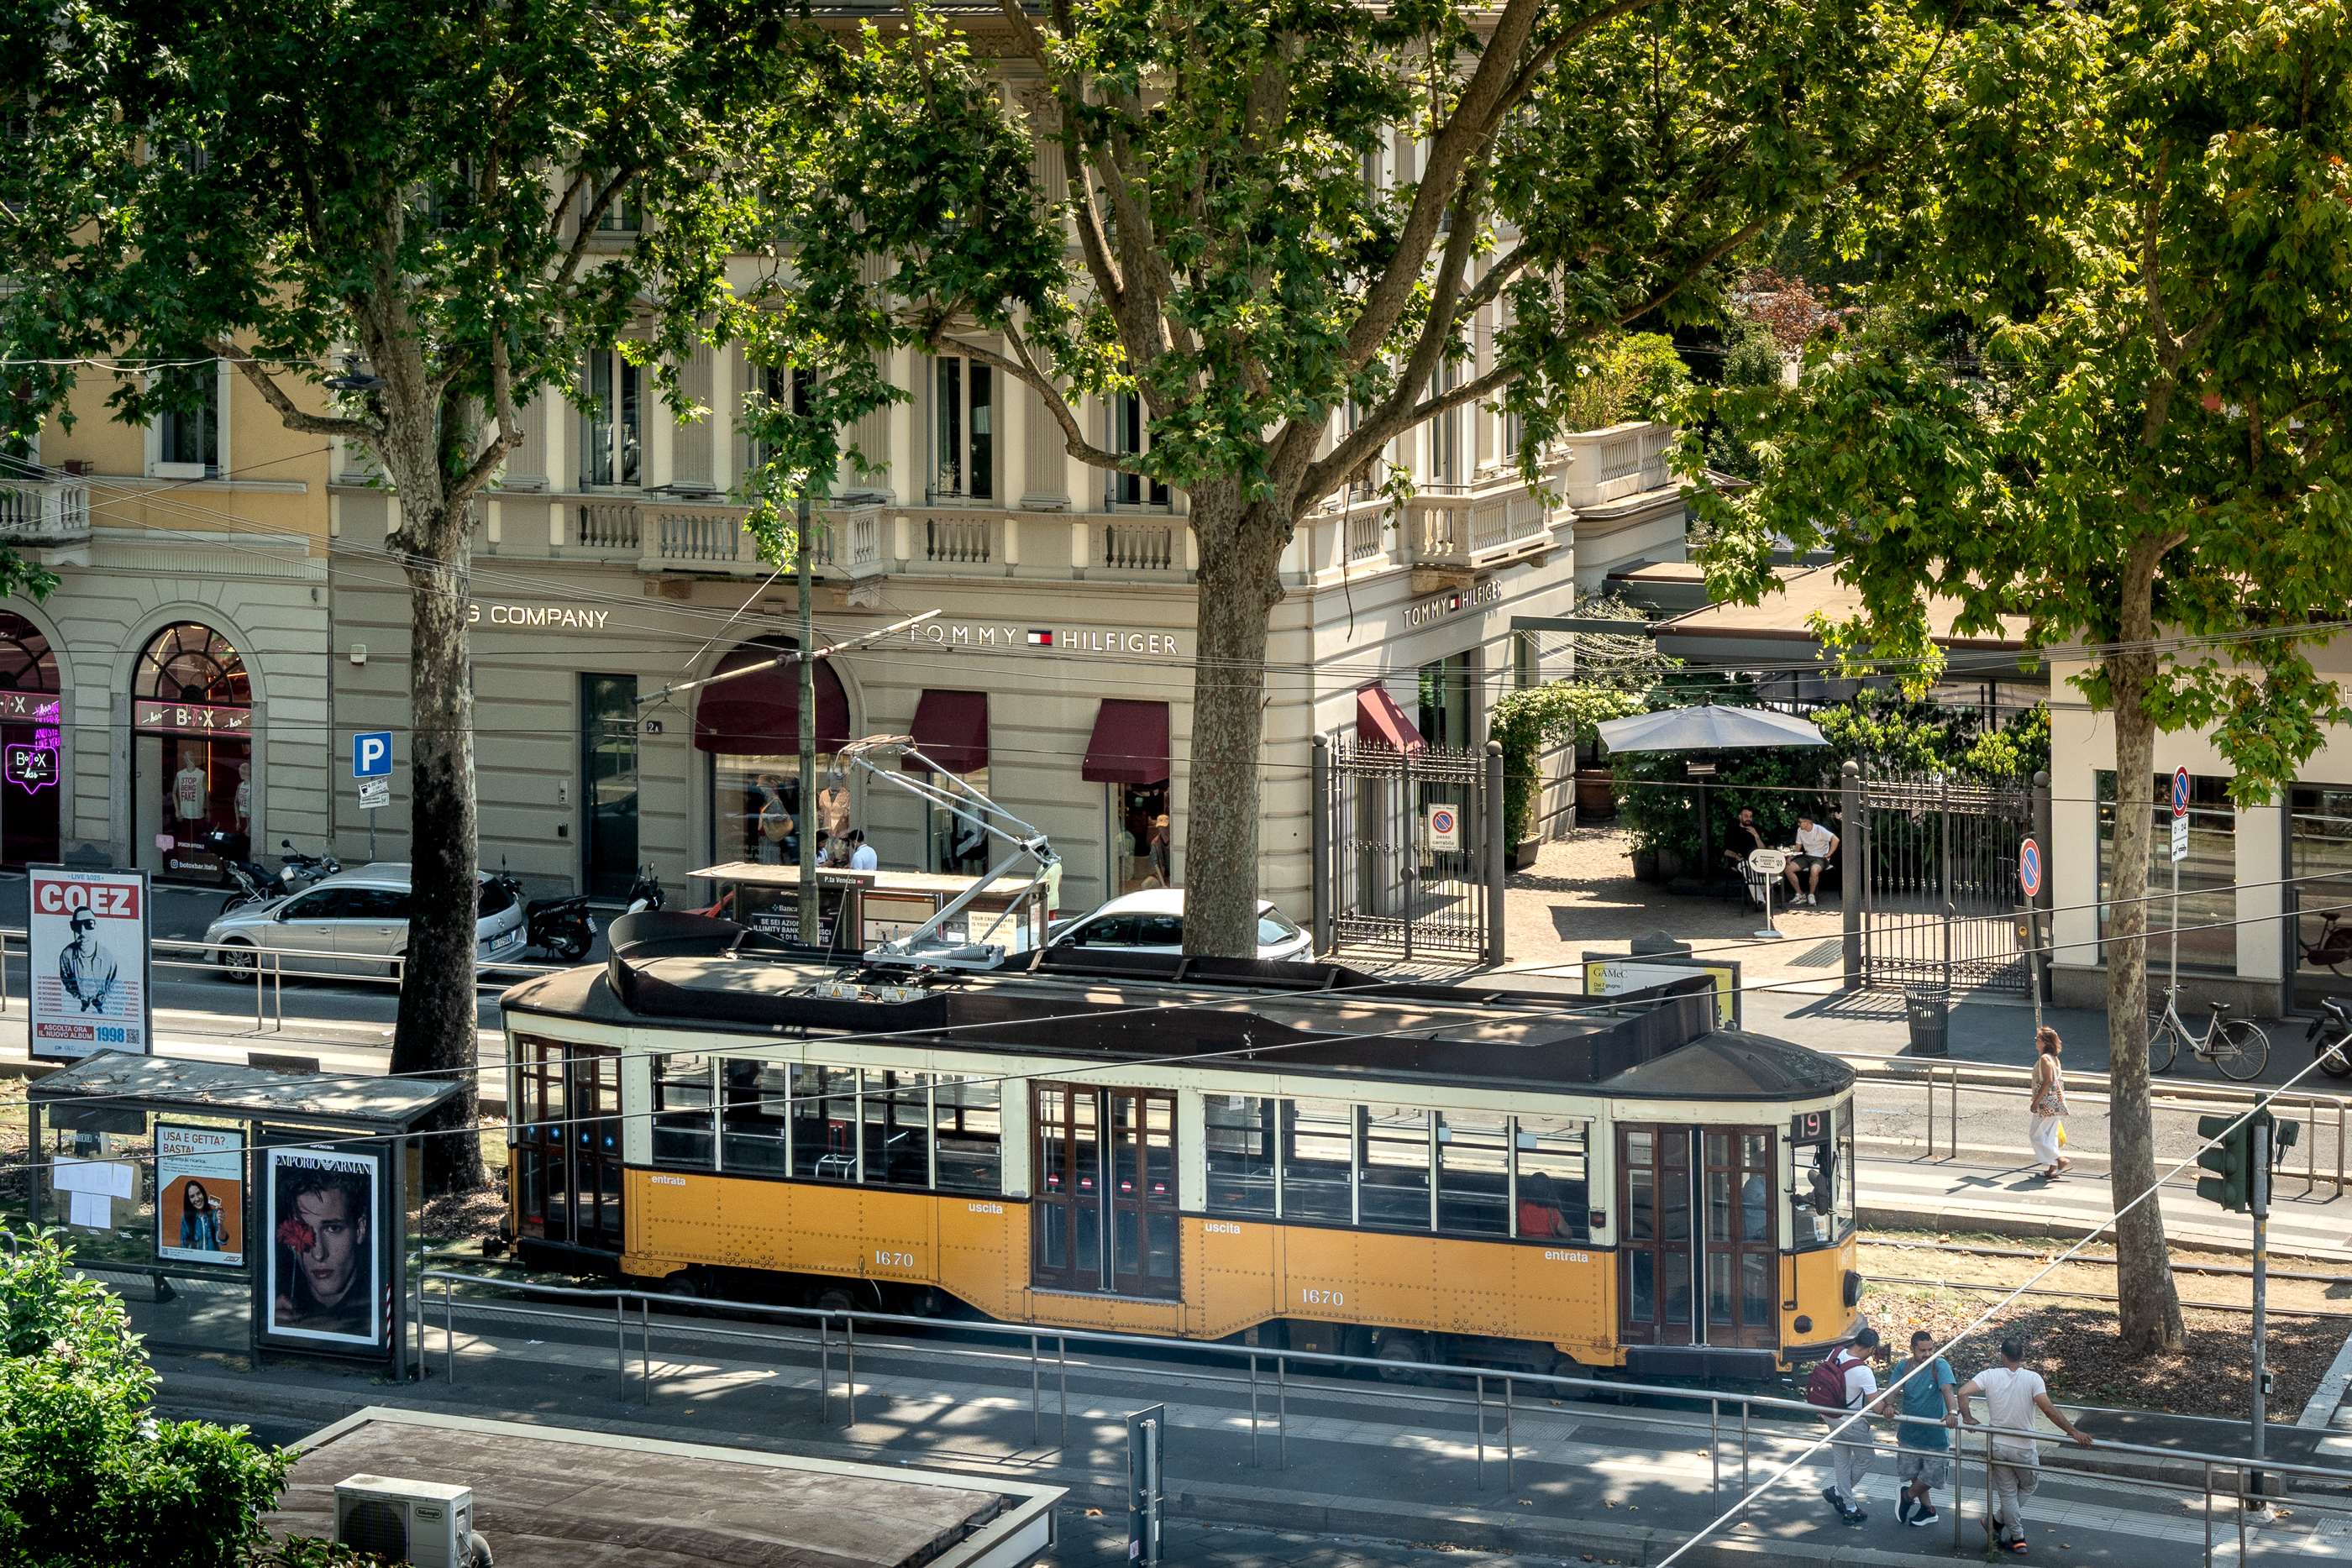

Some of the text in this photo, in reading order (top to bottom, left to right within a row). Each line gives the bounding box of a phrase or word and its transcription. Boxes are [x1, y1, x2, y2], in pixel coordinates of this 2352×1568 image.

[1404, 579, 1503, 627] TOMMY HILFIGER
[491, 606, 609, 629] COMPANY
[911, 623, 1179, 654] TOMMY HILFIGER
[49, 737, 60, 747] YOU
[362, 738, 385, 772] P
[181, 791, 197, 802] FAKE
[179, 862, 218, 871] botoxbar.italia
[835, 876, 856, 884] Venezia
[39, 884, 131, 915] COEZ
[1593, 968, 1628, 979] GAMeC
[44, 1024, 73, 1032] ASCOLTA
[96, 1026, 125, 1043] 1998
[1800, 1112, 1821, 1138] 19
[163, 1130, 226, 1146] USA E GETTA?
[163, 1143, 194, 1154] BASTA!
[275, 1154, 372, 1175] EMPORIO ARMANI
[651, 1175, 687, 1186] entrata
[968, 1203, 1004, 1214] uscita
[1205, 1223, 1242, 1235] uscita
[875, 1250, 914, 1268] 1670
[1544, 1250, 1589, 1263] entrata
[1302, 1288, 1344, 1307] 1670
